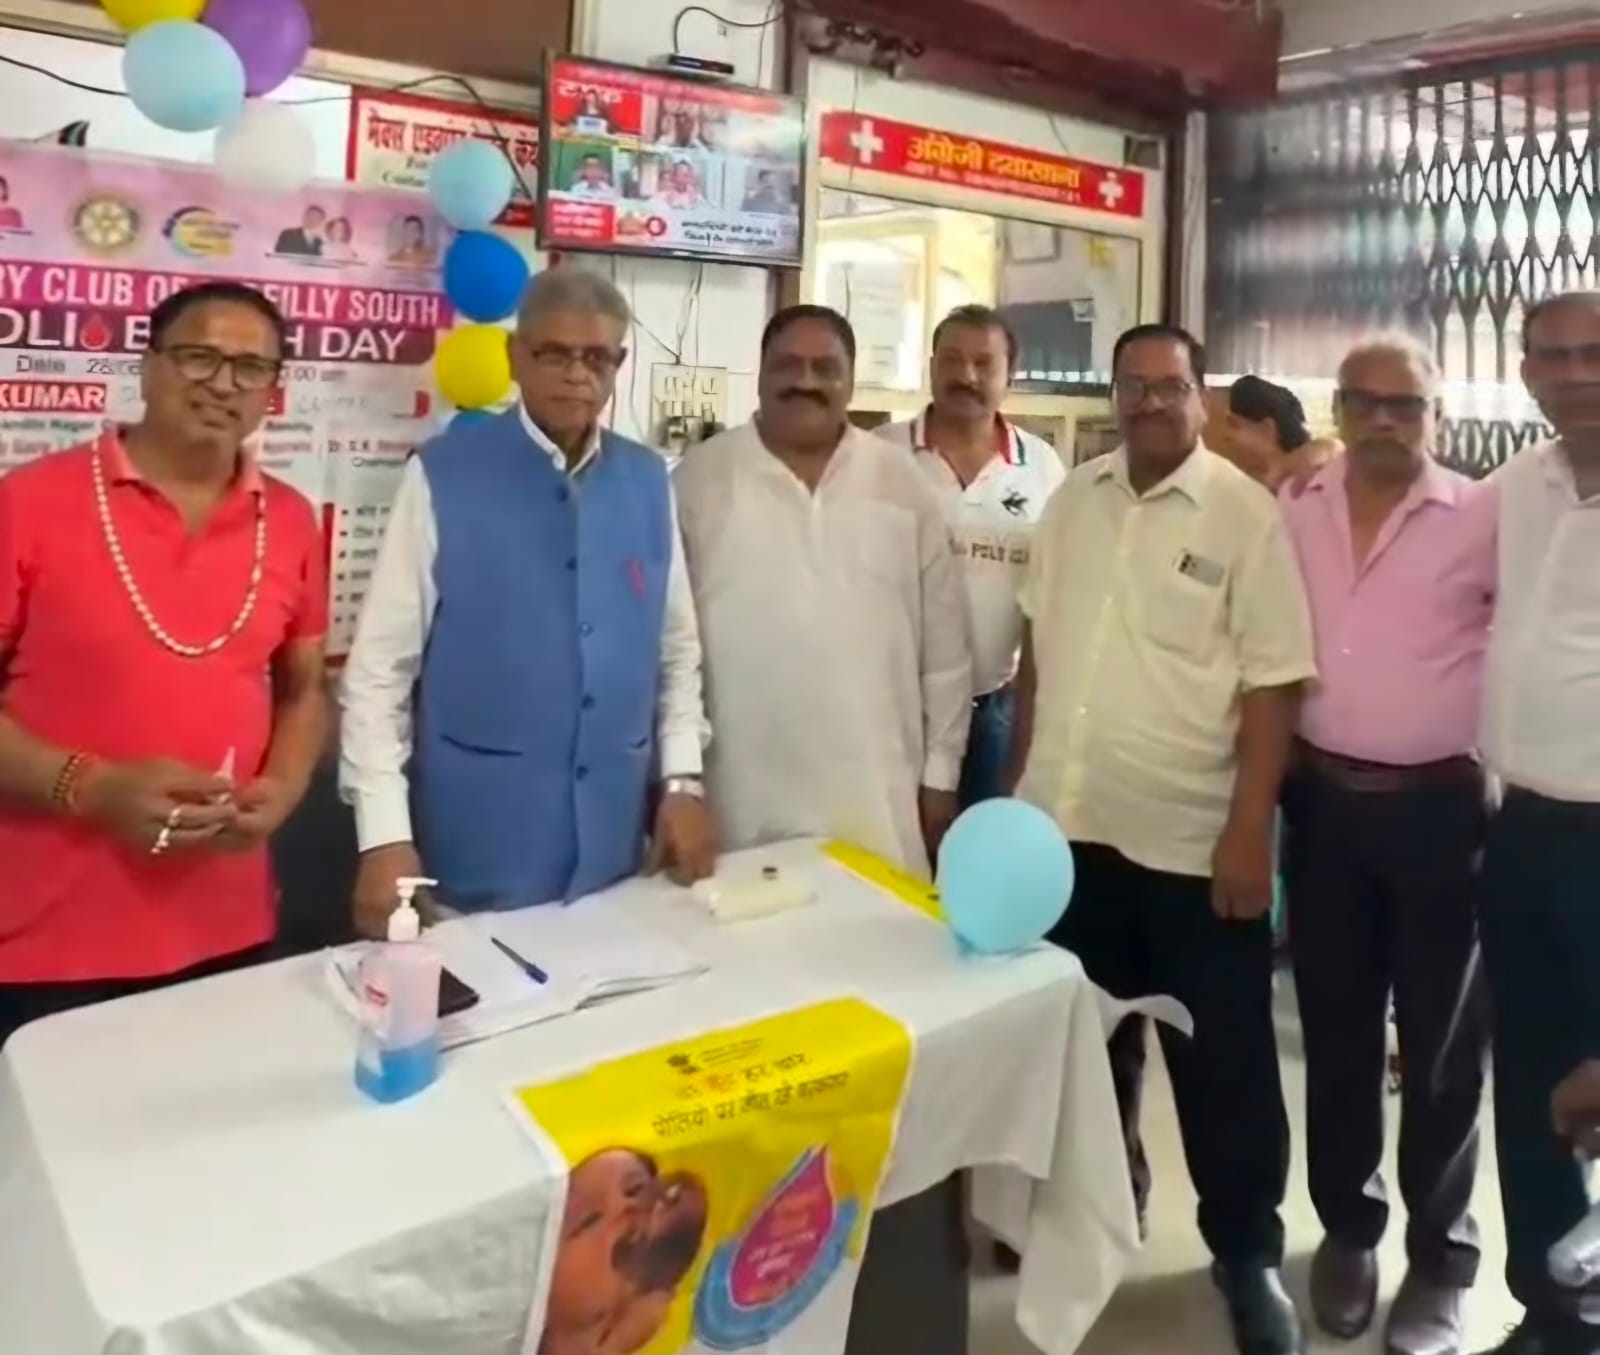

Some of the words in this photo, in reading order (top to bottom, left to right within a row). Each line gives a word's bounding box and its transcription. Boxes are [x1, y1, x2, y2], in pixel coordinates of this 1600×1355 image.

[43, 267, 134, 306] CLUB
[349, 290, 439, 326] SOUTH
[319, 326, 406, 361] DAY
